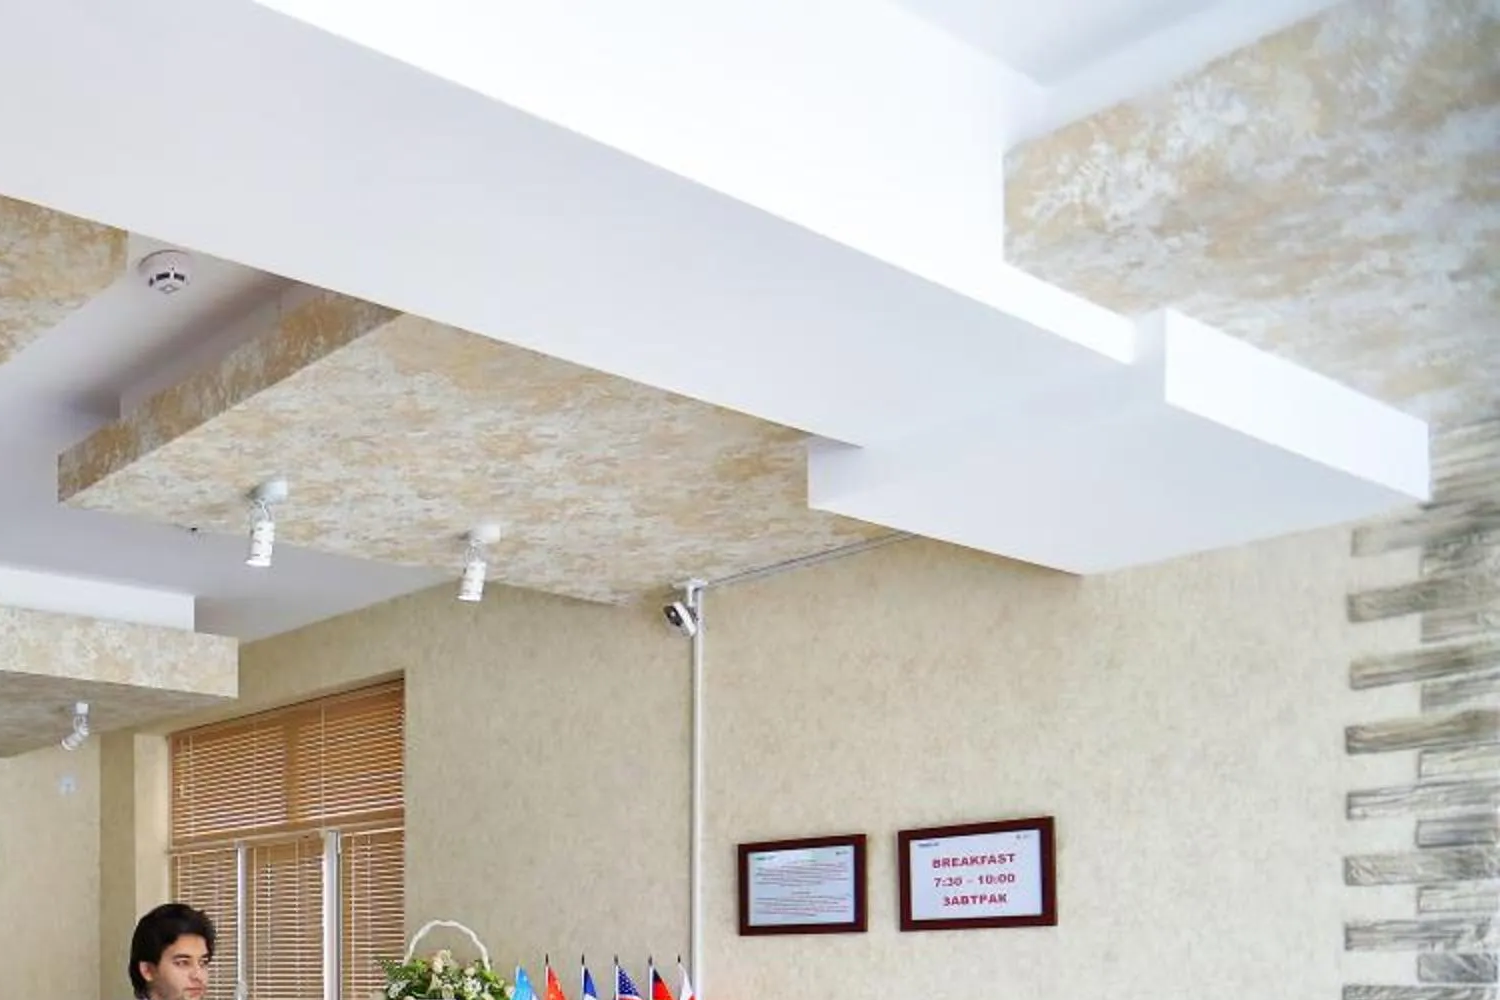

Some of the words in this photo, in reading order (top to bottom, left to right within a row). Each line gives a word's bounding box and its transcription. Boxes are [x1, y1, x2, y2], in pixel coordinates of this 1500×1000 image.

[932, 853, 1016, 869] BREAKFAST
[934, 876, 963, 887] 7:30
[978, 874, 1015, 885] 10:00
[943, 893, 1007, 906] ЗАВТРАК
